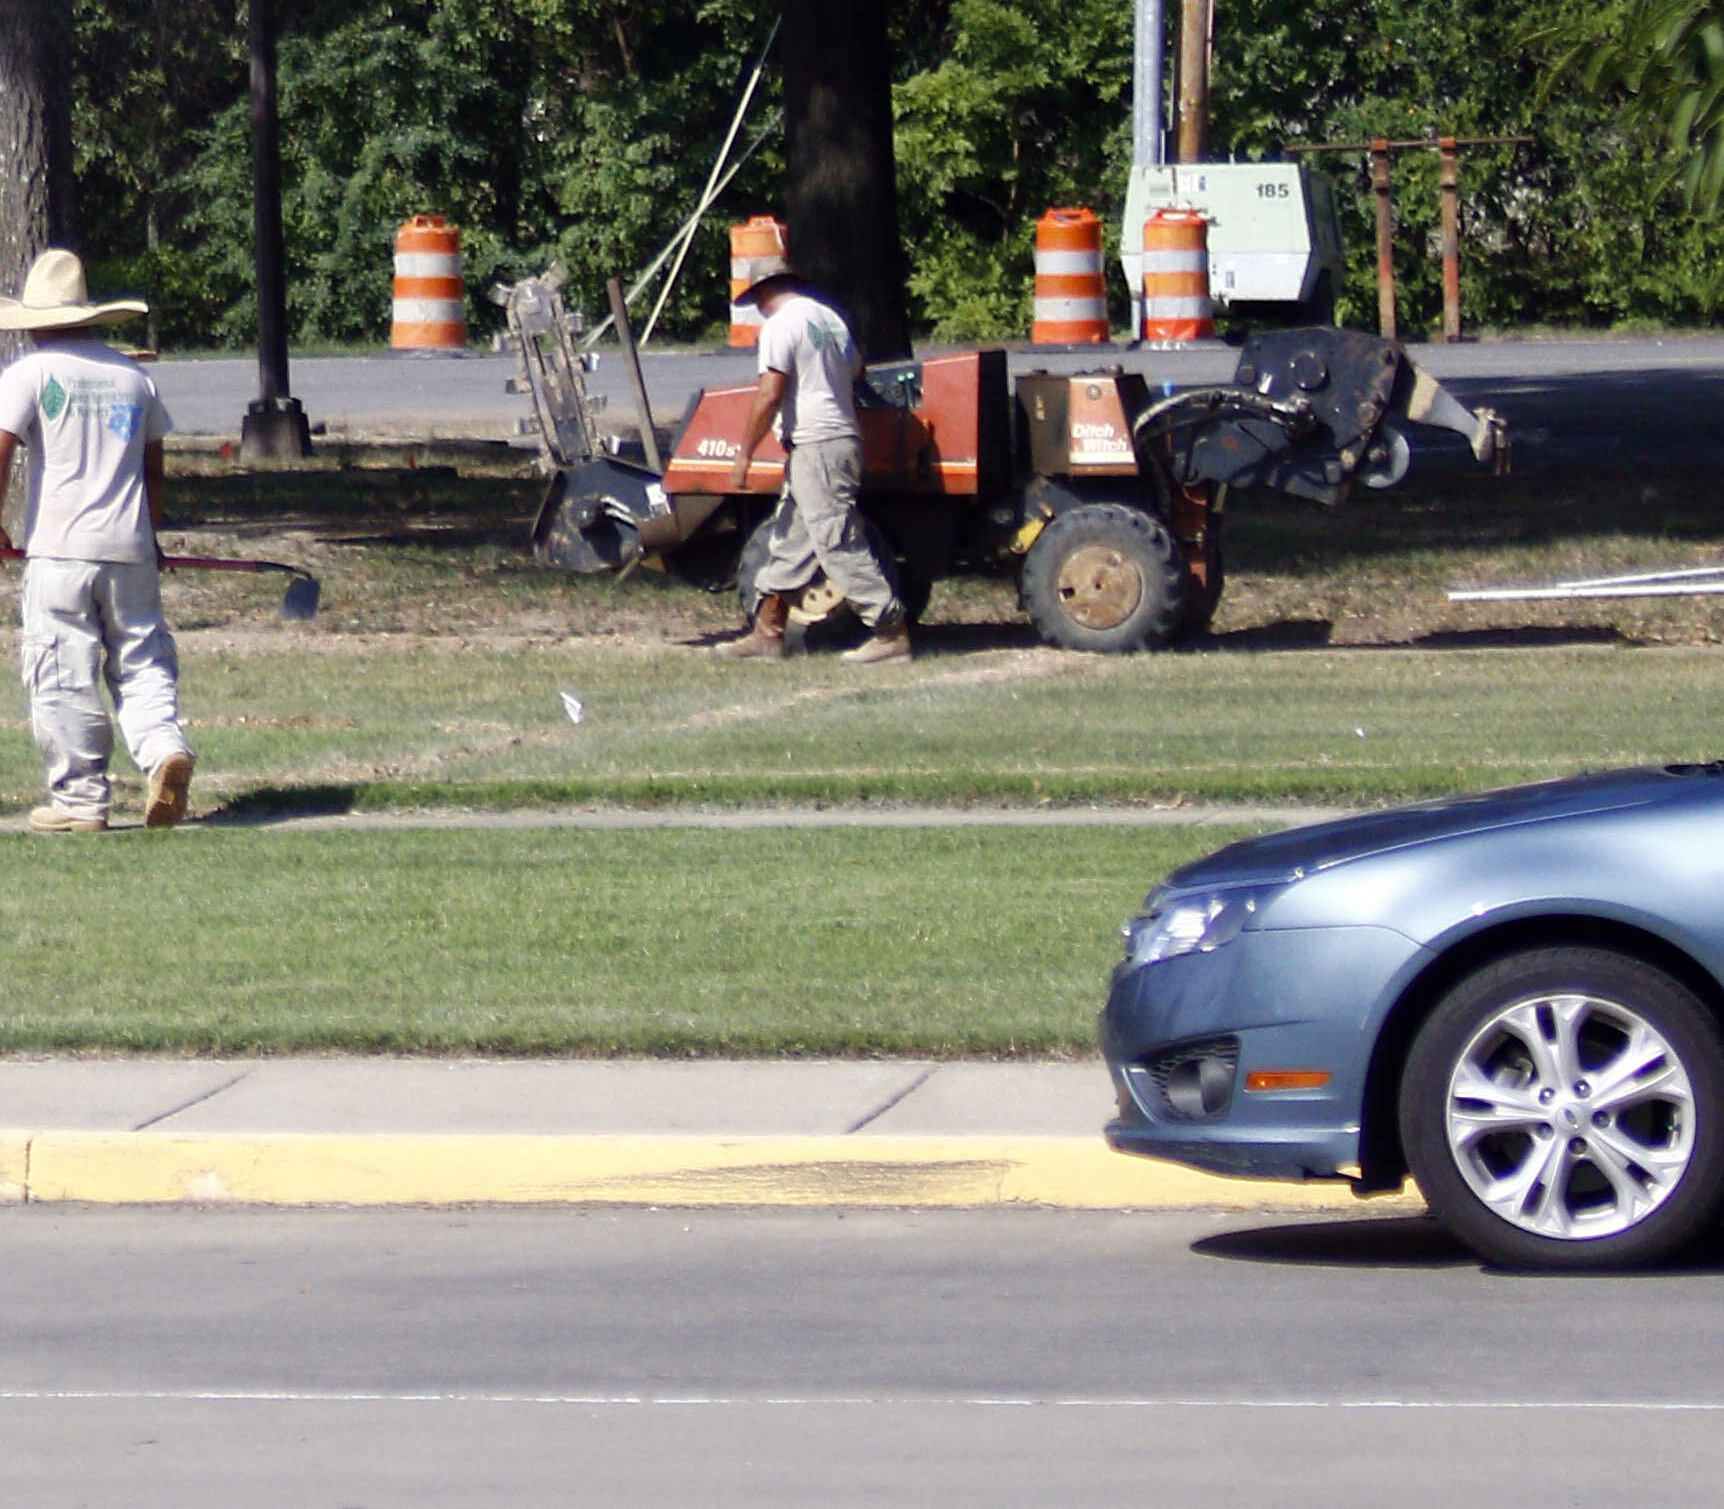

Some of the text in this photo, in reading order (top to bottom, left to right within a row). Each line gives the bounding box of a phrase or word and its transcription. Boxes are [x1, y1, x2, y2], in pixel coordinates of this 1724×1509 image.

[1256, 183, 1290, 198] 185
[1072, 423, 1115, 438] Ditch
[1082, 436, 1128, 452] Witch
